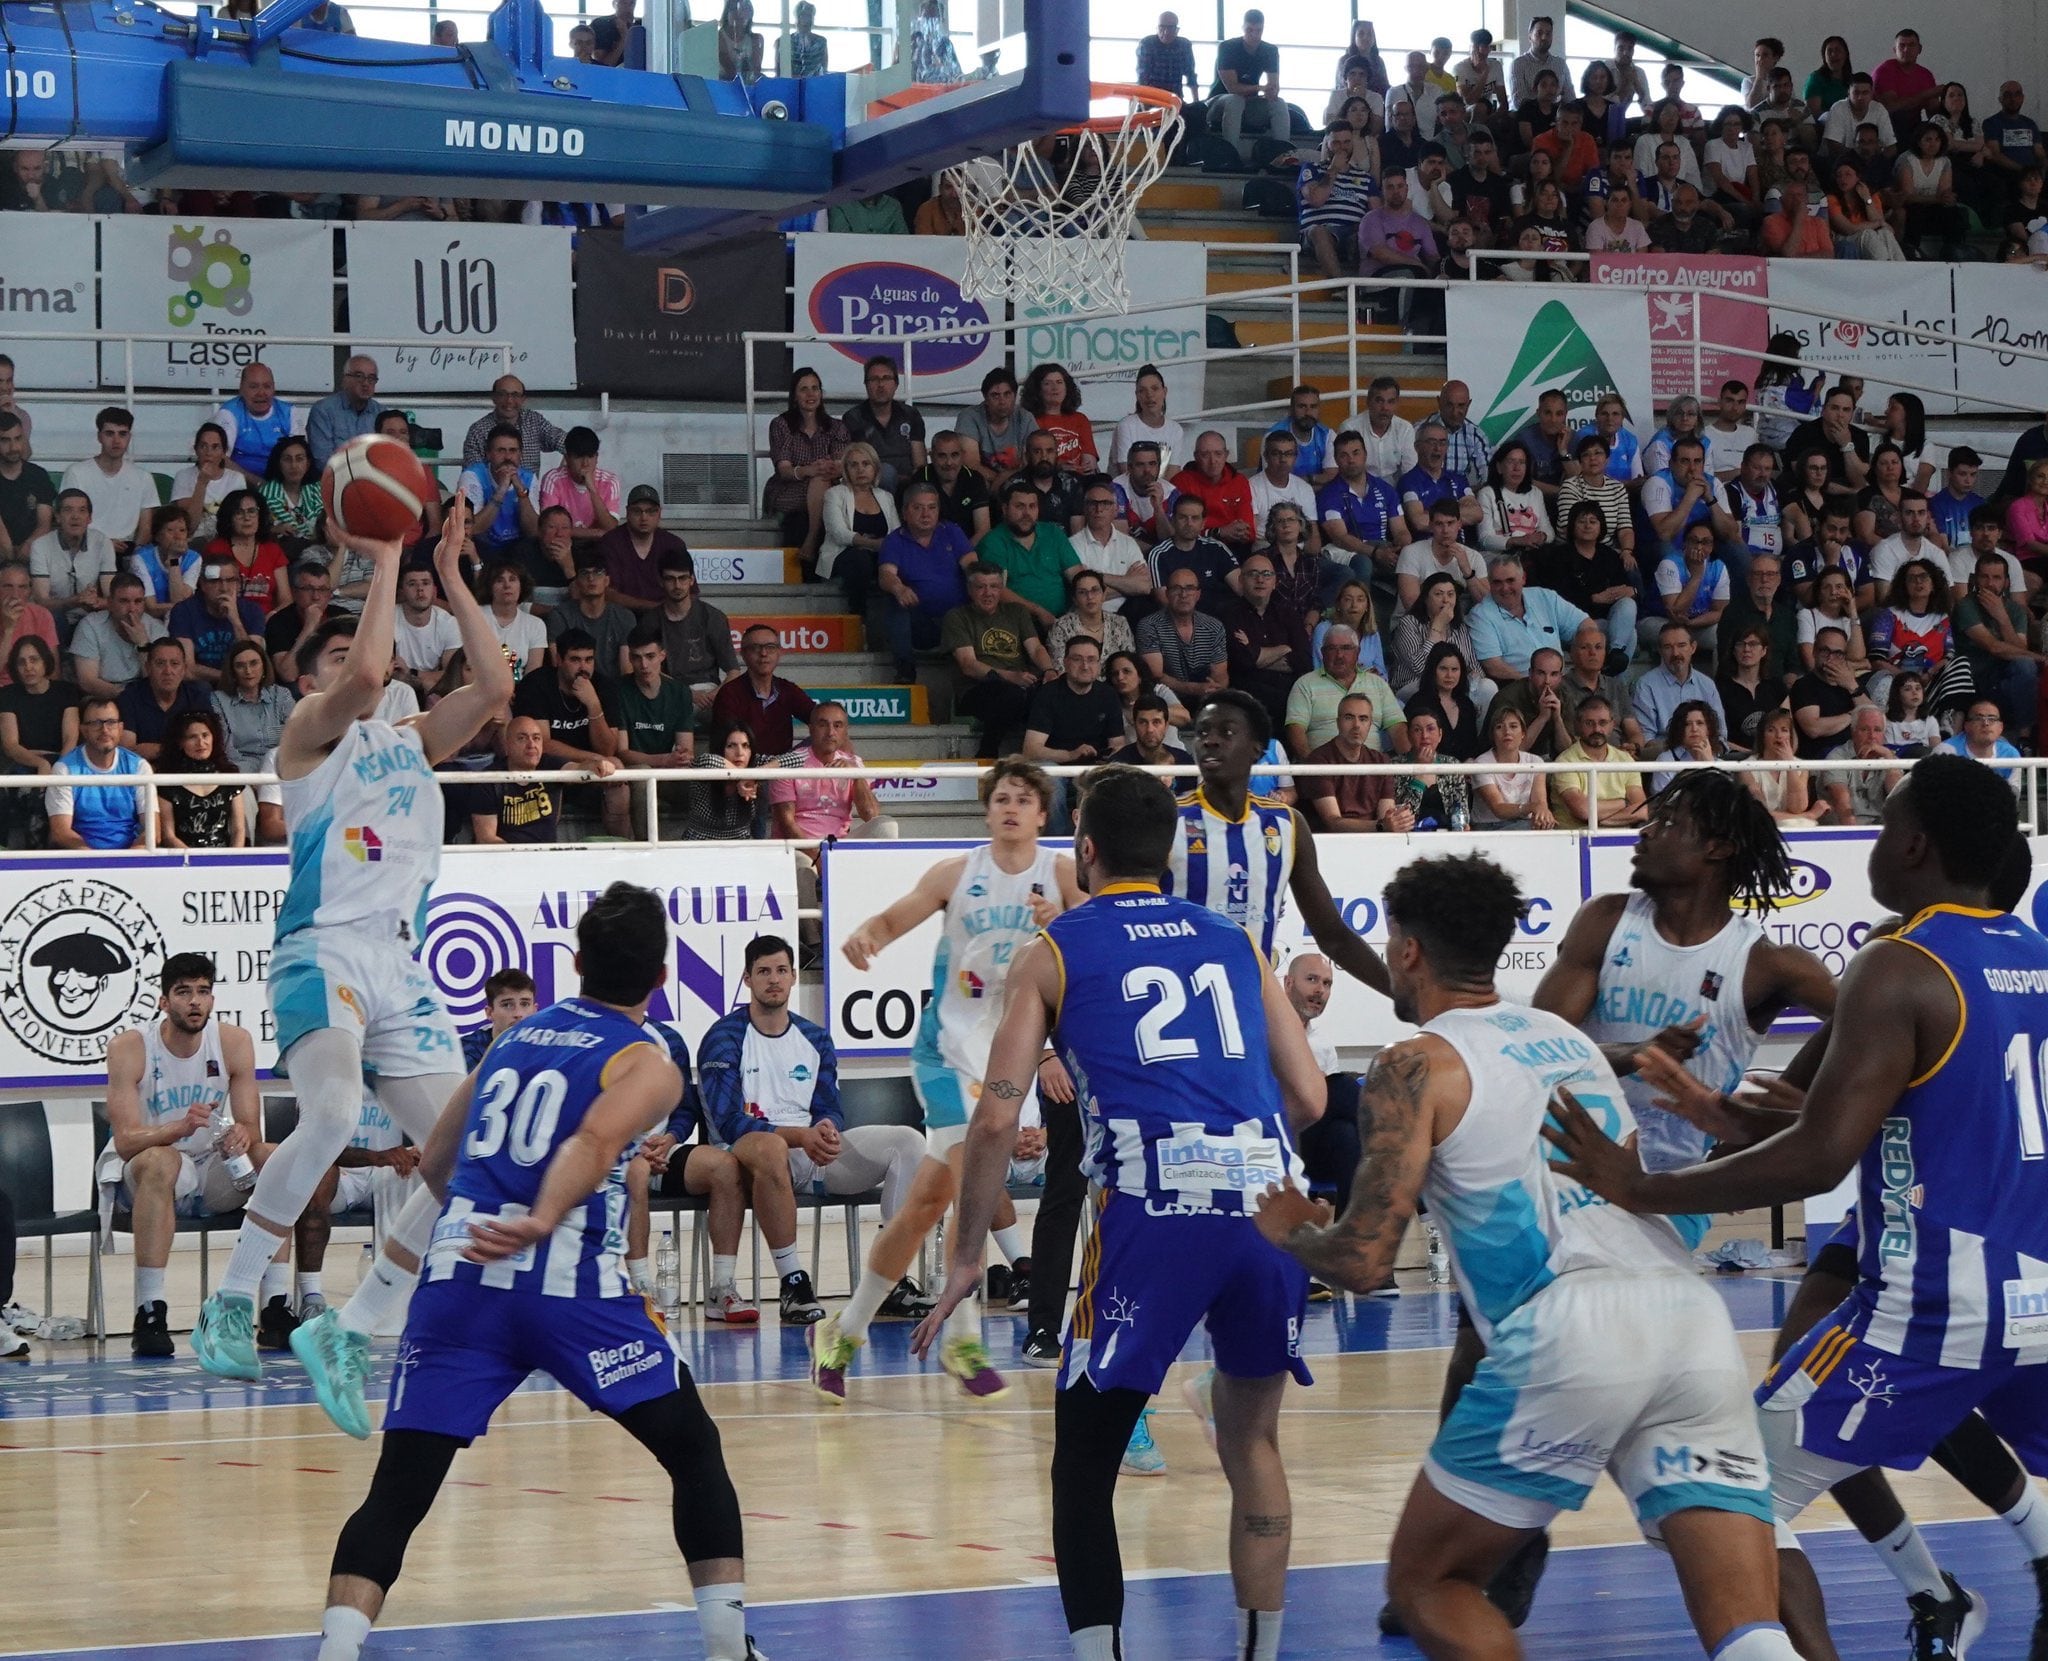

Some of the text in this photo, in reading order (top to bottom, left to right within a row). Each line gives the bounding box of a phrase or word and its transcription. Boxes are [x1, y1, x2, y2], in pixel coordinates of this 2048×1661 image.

[445, 119, 586, 157] MONDO
[1597, 263, 1757, 289] Centro Aveyron
[869, 283, 940, 305] Aguas do
[838, 295, 986, 346] Paraño
[603, 327, 658, 342] David
[167, 340, 267, 367] Laser
[395, 346, 419, 373] by
[1762, 532, 1776, 547] 15
[779, 626, 829, 650] uto
[386, 784, 417, 817] 24
[13, 886, 148, 939] TXAPELA
[1122, 918, 1198, 942] JORDÁ
[991, 941, 1012, 965] 12
[1121, 962, 1247, 1067] 21
[414, 1025, 453, 1054] 24
[464, 1067, 569, 1167] 30
[1160, 1139, 1244, 1165] intra
[1226, 1164, 1281, 1190] gas
[587, 1339, 645, 1374] Bierzo
[597, 1350, 664, 1390] Enoturismo
